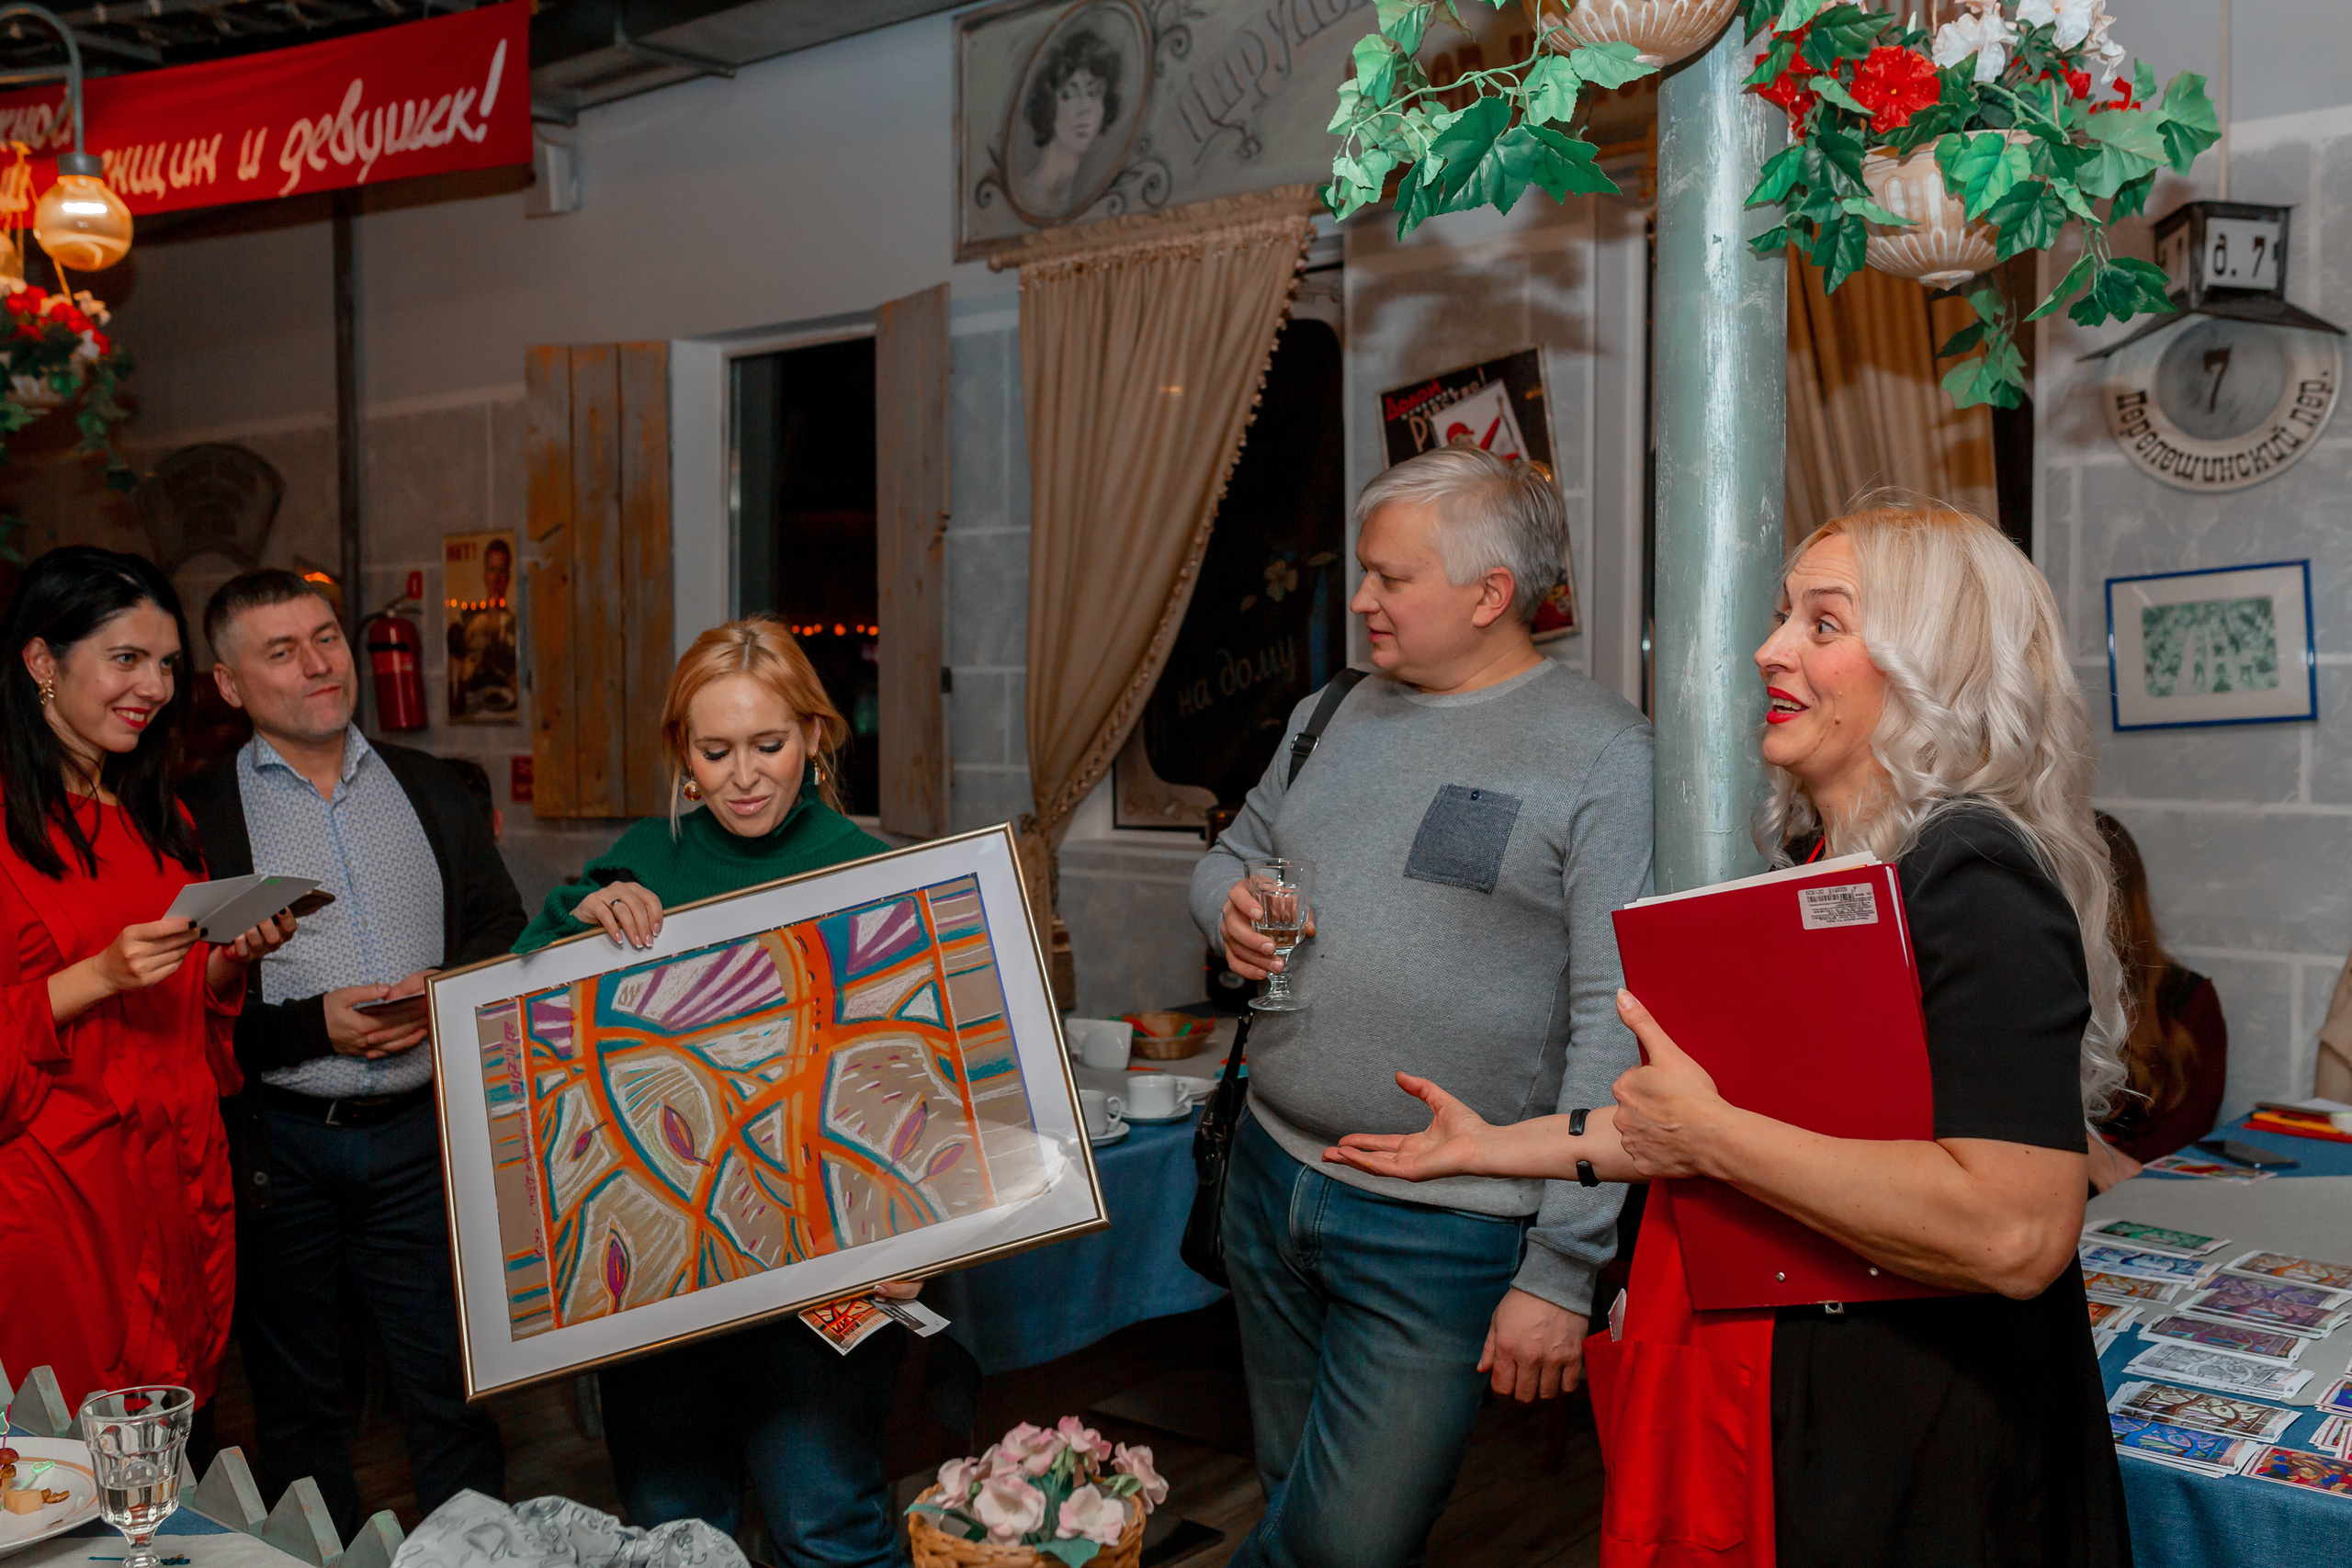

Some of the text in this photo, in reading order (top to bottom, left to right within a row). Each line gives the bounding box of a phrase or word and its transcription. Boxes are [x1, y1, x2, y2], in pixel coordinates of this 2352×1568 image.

[237, 127, 268, 181] и
[279, 38, 507, 197] девушек!
[2253, 235, 2267, 277] 7
[2203, 346, 2233, 413] 7
[2116, 389, 2301, 482] Перелешинский
[1216, 635, 1296, 697] дому
